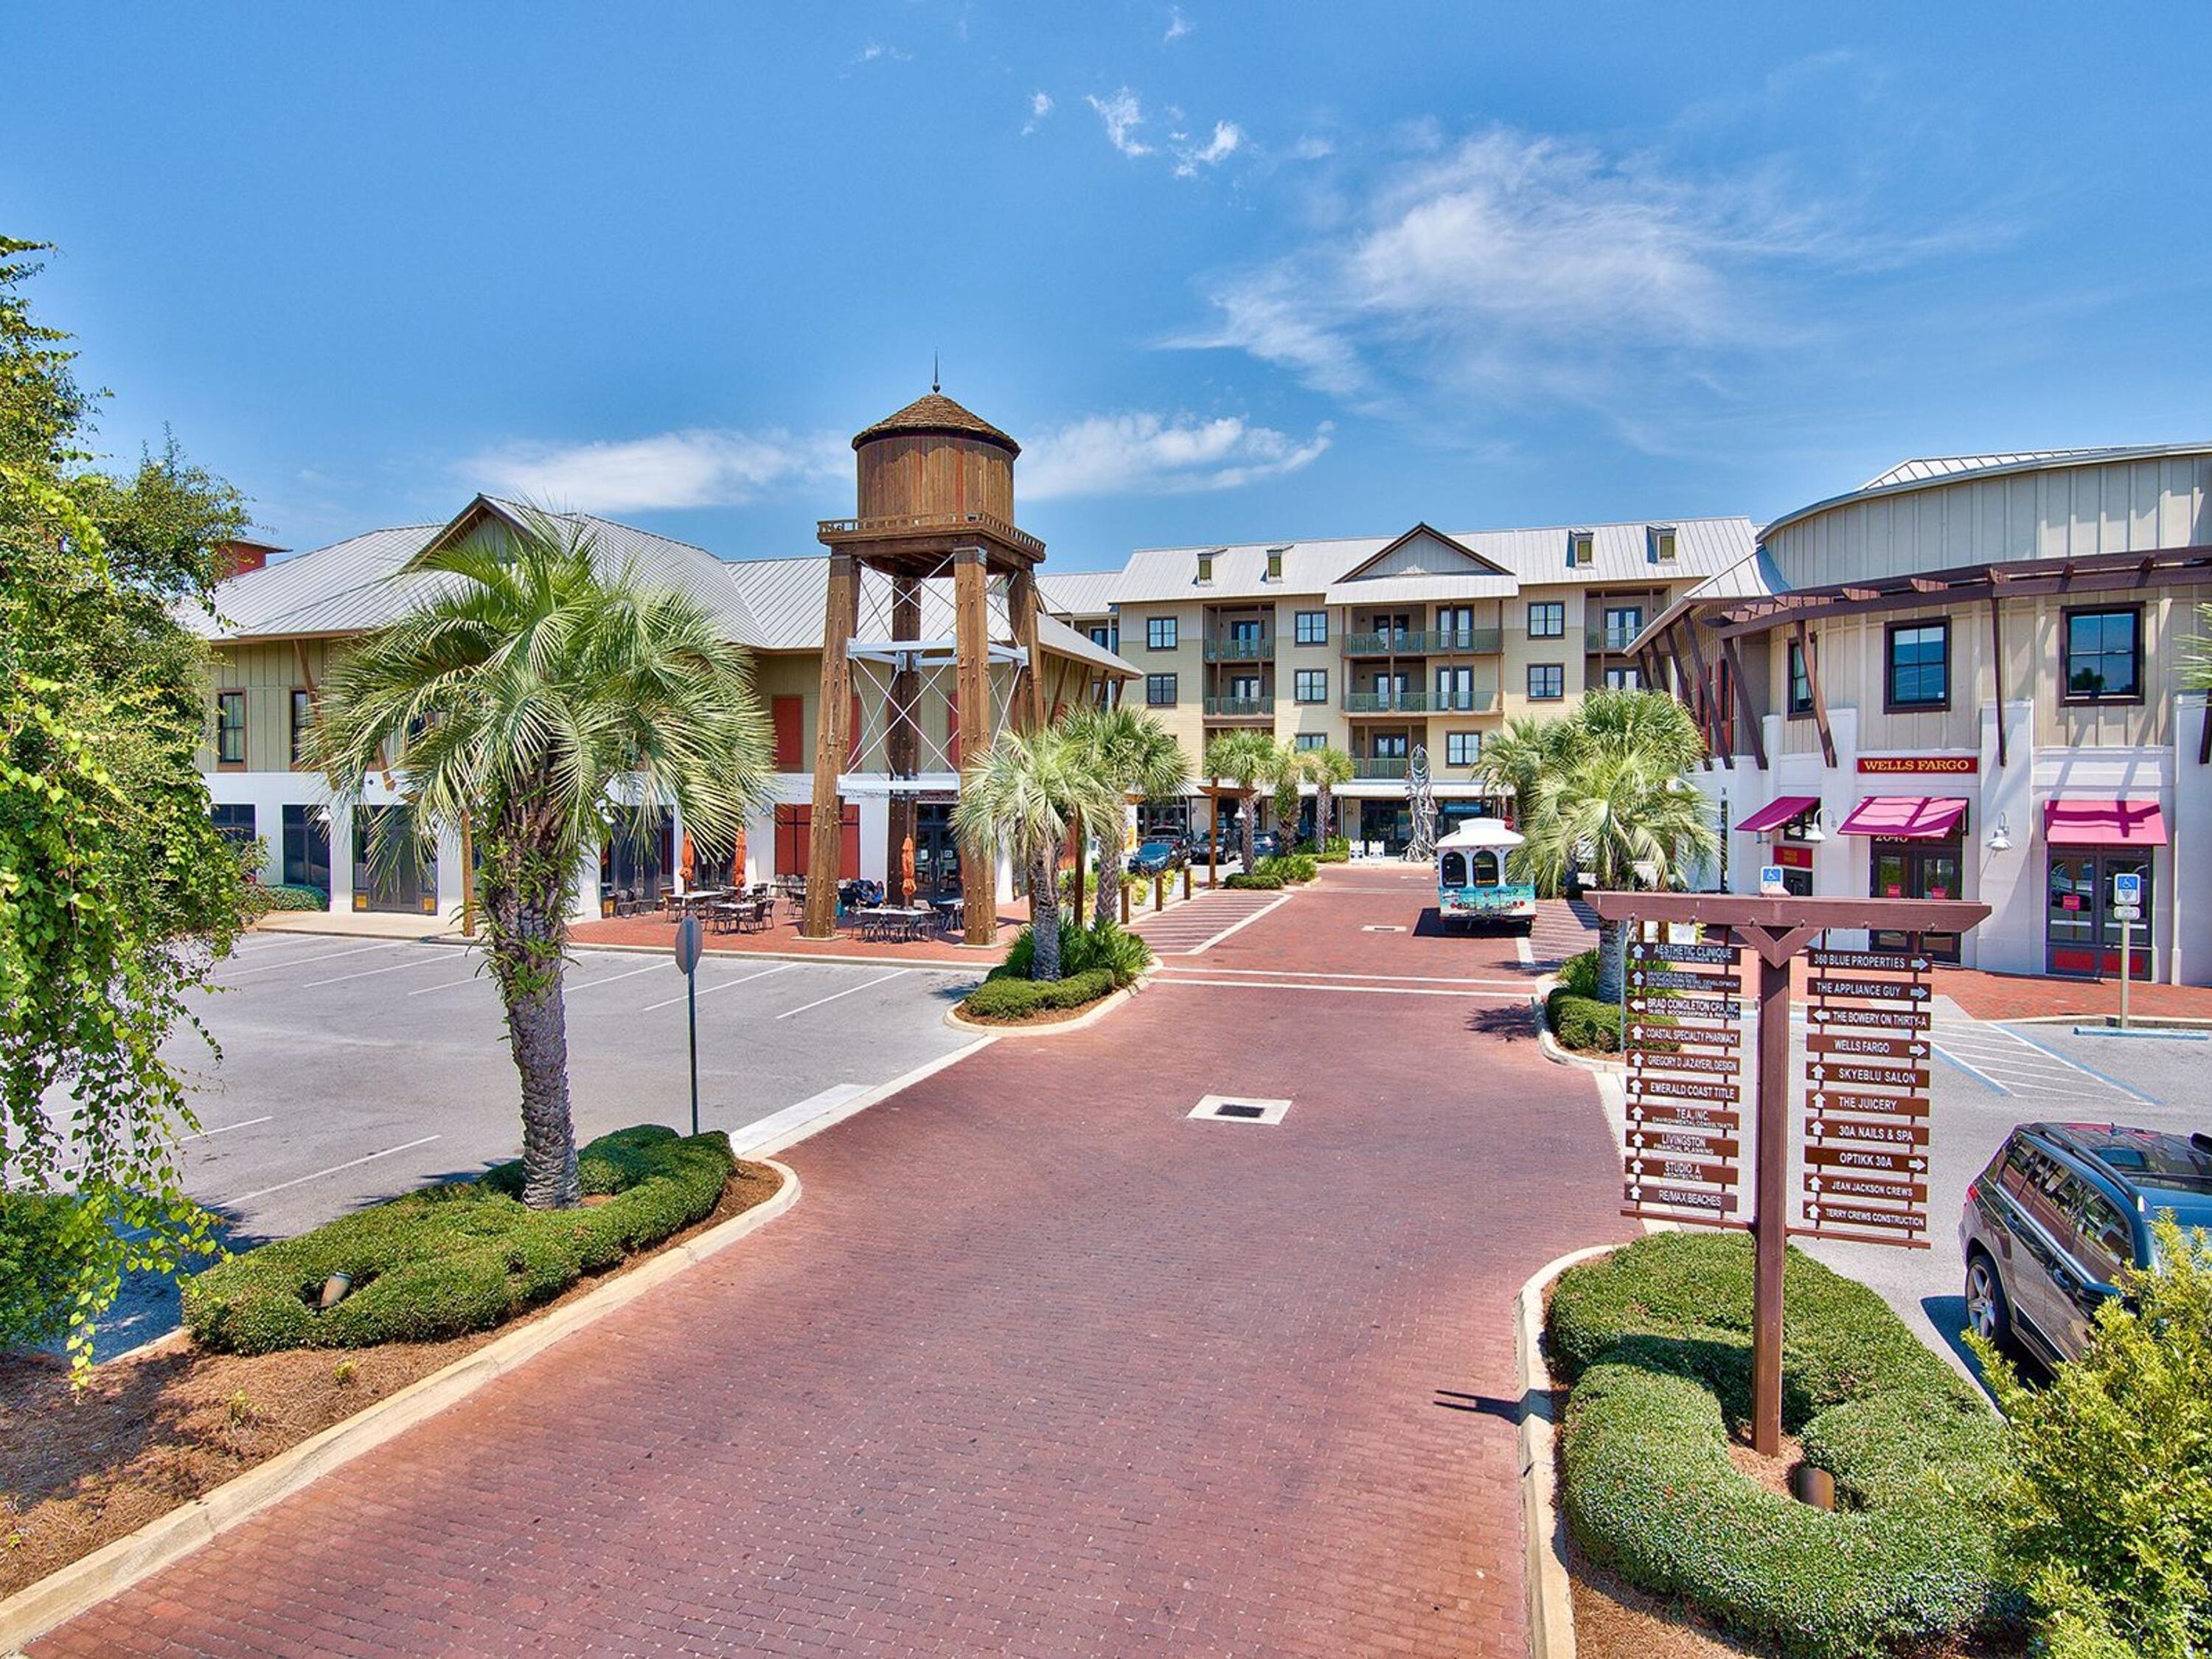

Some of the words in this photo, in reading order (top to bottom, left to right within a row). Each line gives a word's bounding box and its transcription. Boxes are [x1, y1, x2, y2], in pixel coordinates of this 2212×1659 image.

[1864, 760, 1914, 771] WELLS
[1917, 760, 1969, 771] FARGO
[1653, 945, 1695, 956] AESTHETIC
[1697, 947, 1732, 959] CLINIQUE
[1815, 954, 1828, 964] 360
[1829, 955, 1850, 965] BLUE
[1851, 956, 1905, 968] PROPERTIES
[1816, 982, 1832, 992] THE
[1834, 983, 1881, 996] APPLIANCE
[1883, 987, 1901, 996] GUY
[1646, 998, 1666, 1008] BRAD
[1667, 999, 1710, 1011] CONGLETON
[1833, 1012, 1847, 1022] THE
[1848, 1012, 1880, 1024] BOWERY
[1881, 1014, 1892, 1024] ON
[1893, 1015, 1927, 1026] THIRTY-A
[1646, 1028, 1672, 1039] COASTAL
[1673, 1029, 1705, 1042] SPECIALTY
[1705, 1032, 1739, 1043] PHARMACY
[1834, 1040, 1861, 1051] WELLS
[1863, 1041, 1890, 1053] FARGO
[1647, 1055, 1676, 1066] GREGORY
[1714, 1060, 1737, 1071] DESIGN
[1838, 1068, 1882, 1082] SKYEBLU
[1885, 1071, 1916, 1084] SALON
[1650, 1082, 1686, 1093] EMERALD
[1687, 1085, 1712, 1096] COAST
[1714, 1088, 1735, 1099] TITLE
[1838, 1096, 1856, 1107] THE
[1858, 1098, 1897, 1110] JUICERY
[1661, 1133, 1706, 1147] LIVINGSTON
[1838, 1126, 1856, 1137] 30A
[1858, 1127, 1885, 1139] NAILS
[1887, 1130, 1893, 1140] &
[1896, 1130, 1914, 1141] SPA
[1653, 1144, 1683, 1152] FINANCIAL
[1684, 1147, 1714, 1155] PLANNING
[1839, 1152, 1874, 1165] OPTIKK
[1875, 1155, 1893, 1168] 30A
[1665, 1161, 1693, 1174] STUDIO
[1695, 1164, 1702, 1175] A
[1832, 1181, 1851, 1191] JEAN
[1852, 1183, 1884, 1194] JACKSON
[1885, 1186, 1913, 1197] CREWS
[1659, 1190, 1687, 1203] RE/MAX
[1687, 1193, 1722, 1206] BEACHES
[1826, 1208, 1846, 1219] TERRY
[1847, 1211, 1871, 1221] CREWS
[1873, 1214, 1924, 1227] CONSTRUCTION
